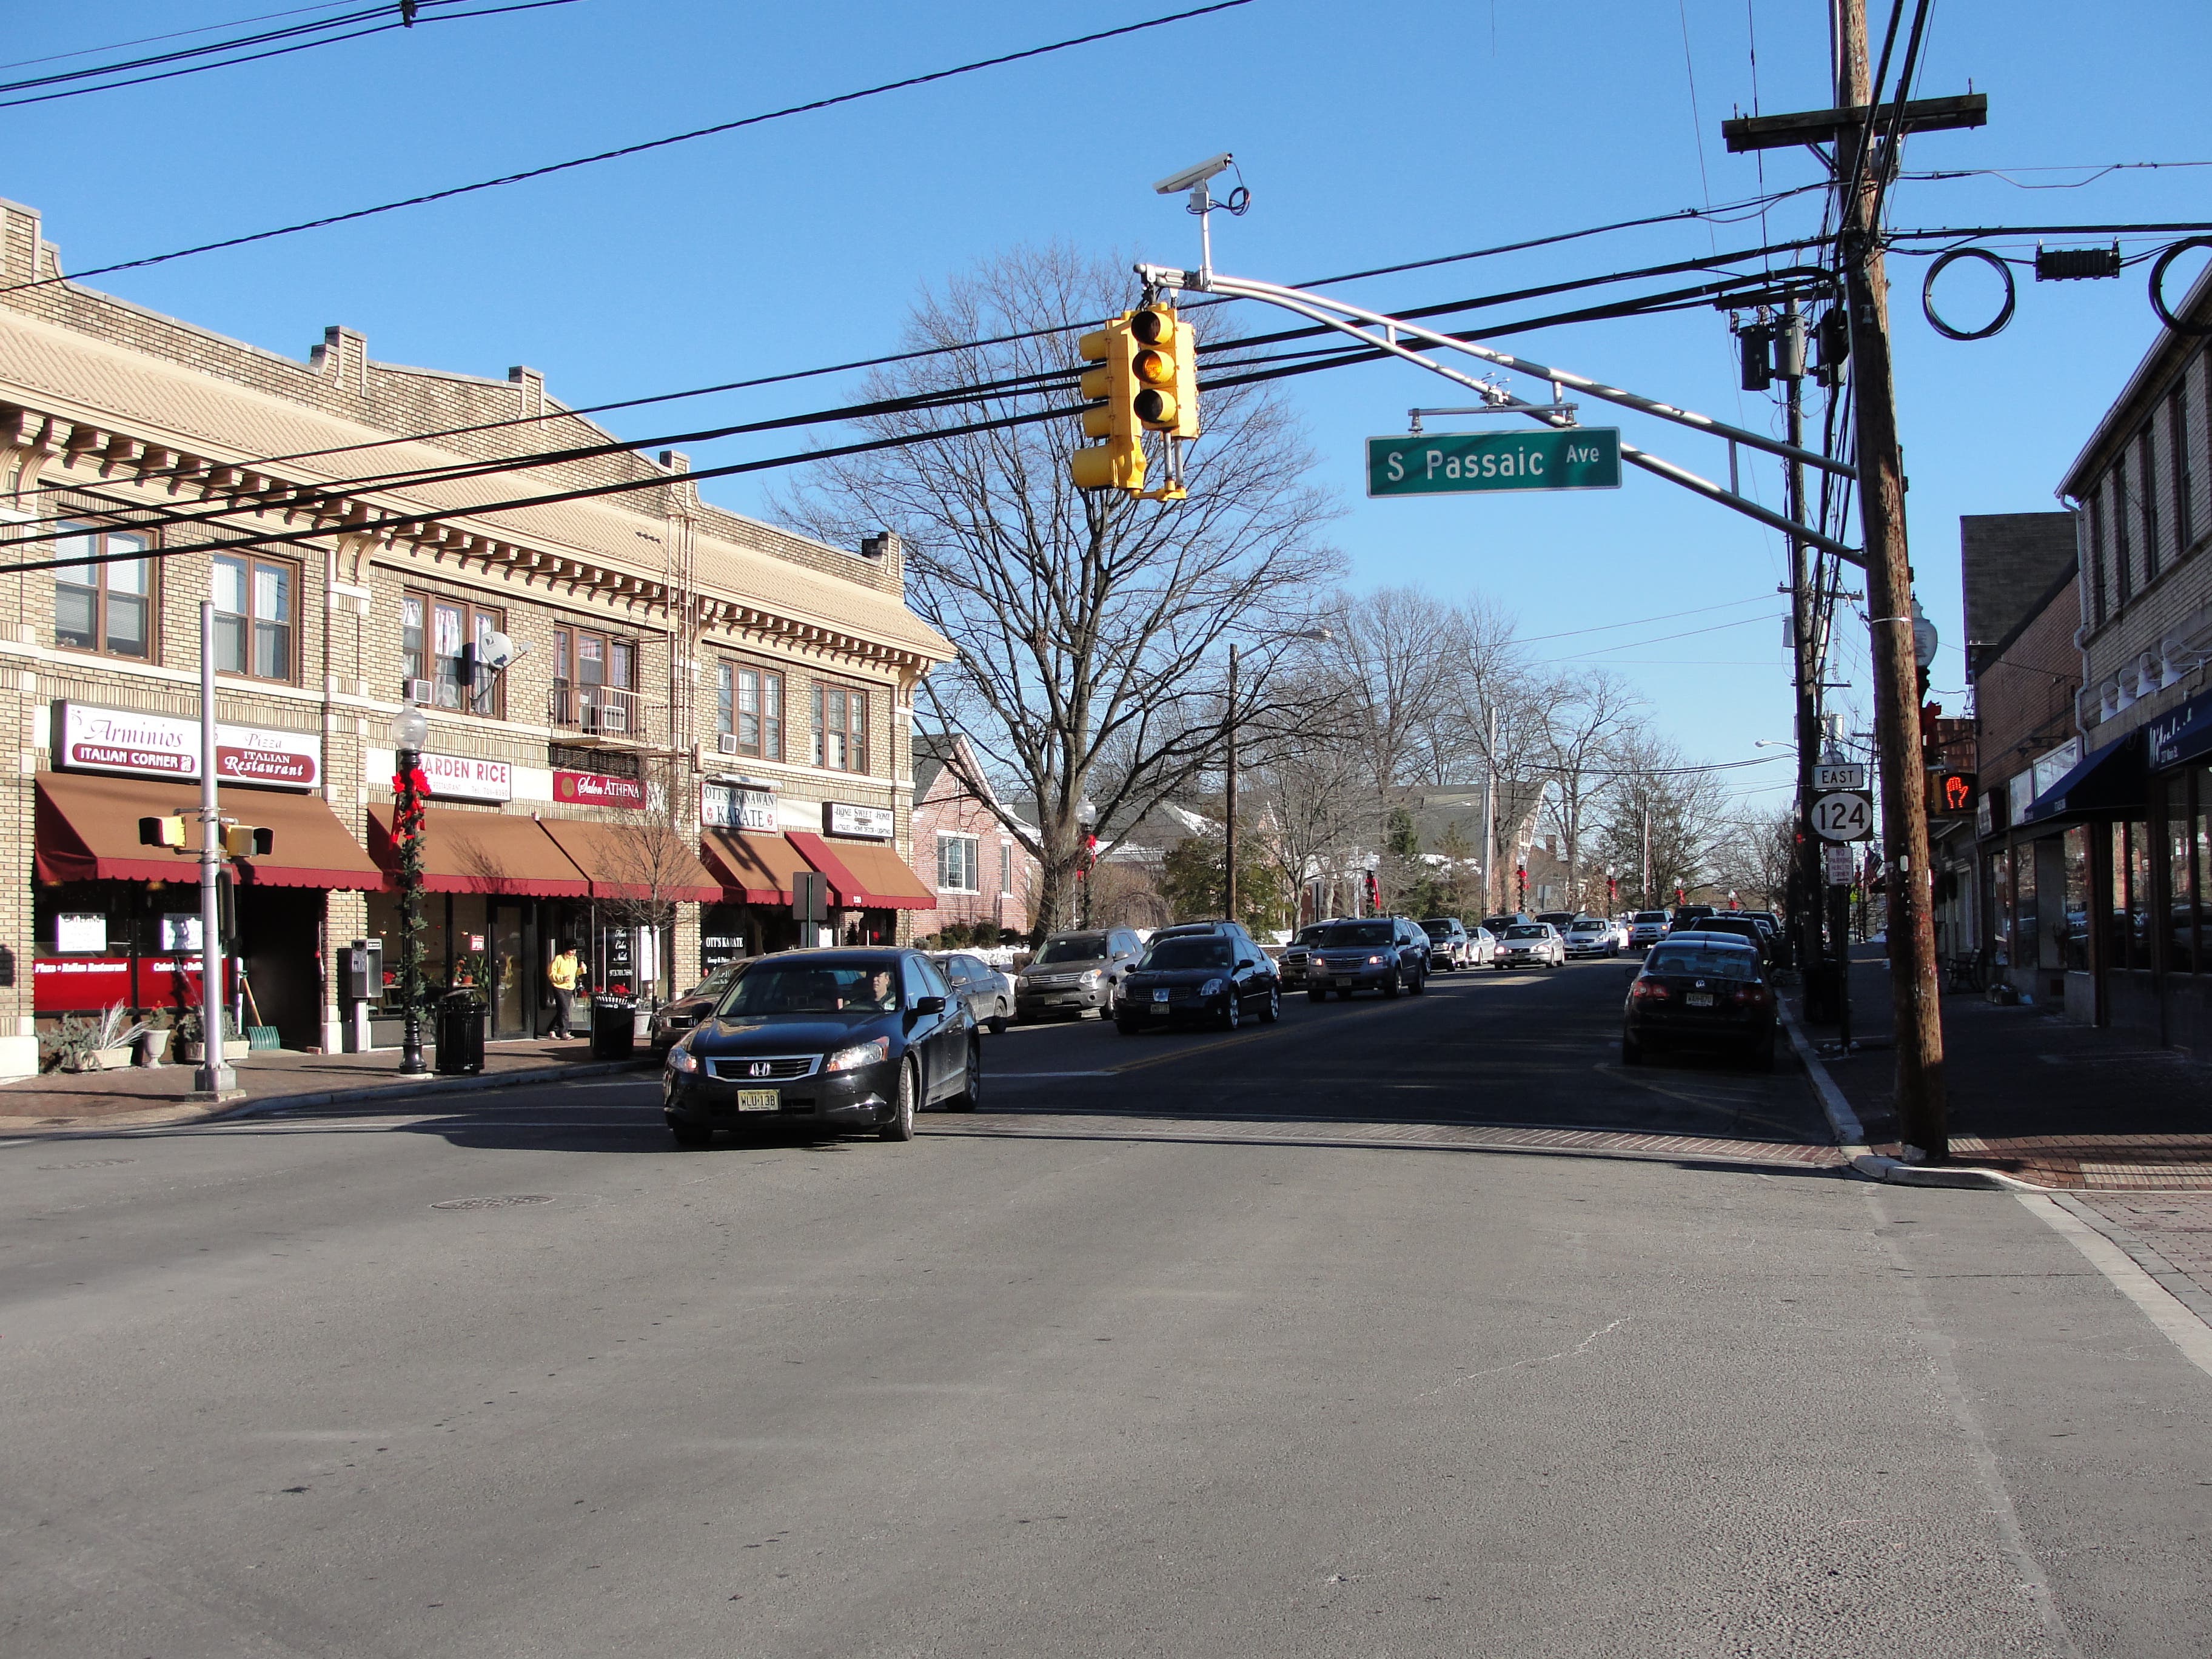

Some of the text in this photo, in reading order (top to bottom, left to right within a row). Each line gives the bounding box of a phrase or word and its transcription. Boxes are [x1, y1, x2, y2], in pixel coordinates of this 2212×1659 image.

[1387, 444, 1600, 481] S Passaic Ave
[84, 719, 183, 747] Arminios
[245, 733, 282, 748] Pizza
[80, 746, 178, 768] ITALIAN CORNER
[224, 756, 304, 777] Restaurant
[243, 751, 290, 763] ITALIAN
[419, 757, 506, 783] ARDEN RICE
[1822, 771, 1854, 783] EAST
[577, 776, 603, 797] Salon
[604, 778, 640, 798] ATHENA
[705, 786, 774, 806] OTT'S OKINAWAN
[717, 806, 764, 827] KARATE
[1820, 802, 1865, 830] 124
[64, 914, 101, 923] CATERING
[706, 937, 743, 947] OTT'S KARATE
[35, 963, 56, 973] Pizza
